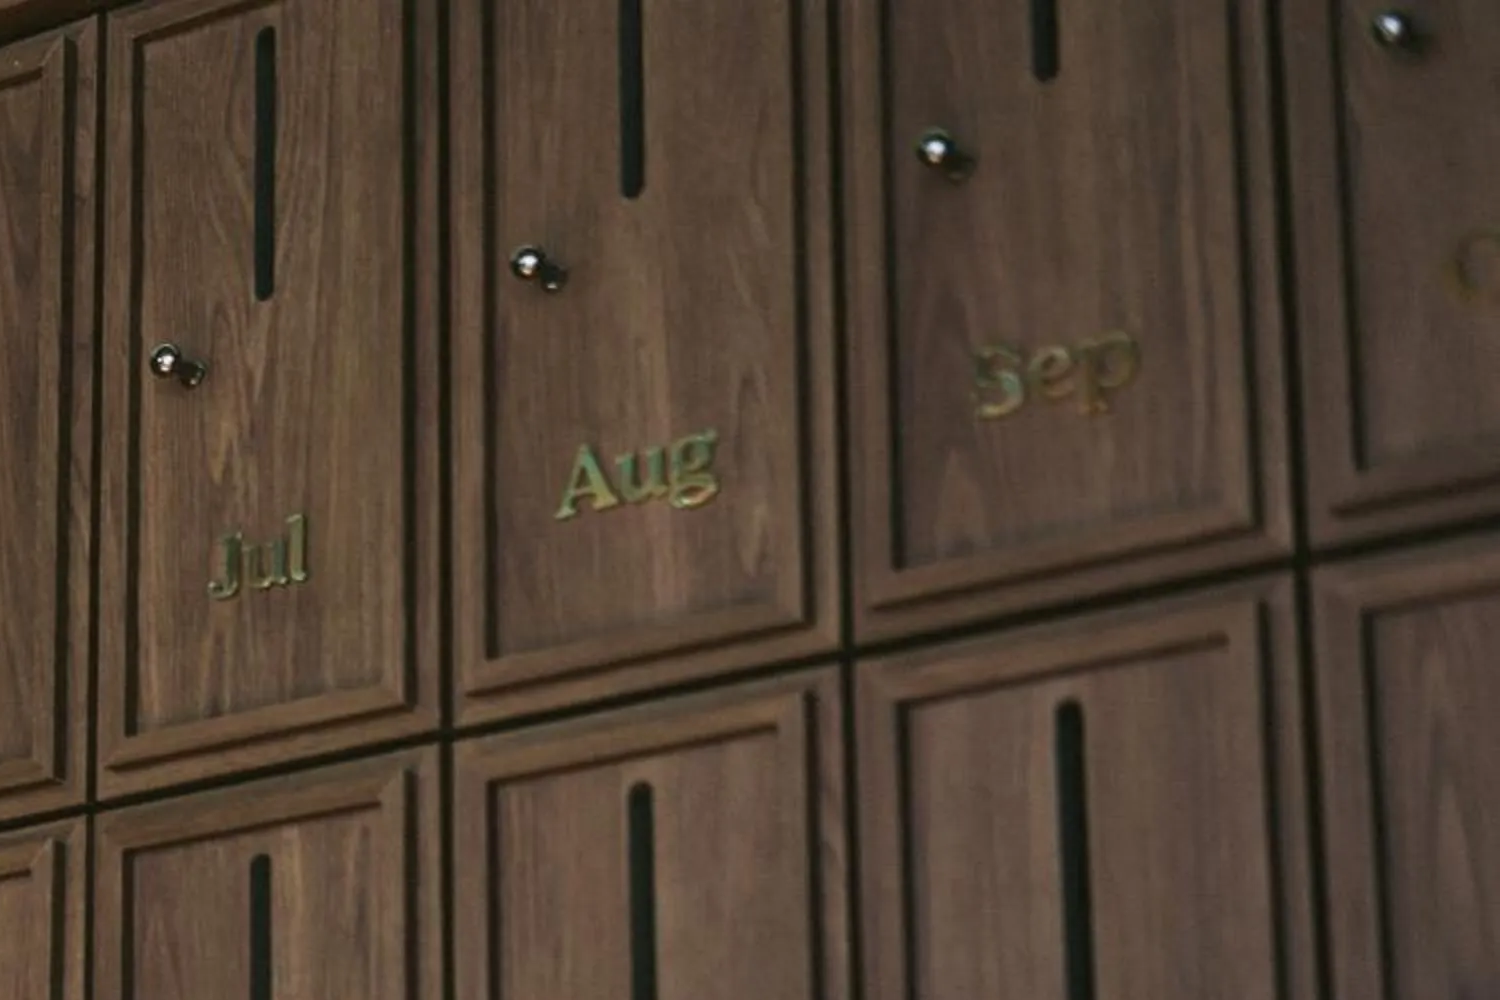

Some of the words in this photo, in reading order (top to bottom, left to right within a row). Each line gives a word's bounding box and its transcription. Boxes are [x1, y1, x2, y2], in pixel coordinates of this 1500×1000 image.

[972, 332, 1141, 420] Sep
[555, 428, 720, 520] Aug
[206, 512, 309, 600] Jul
